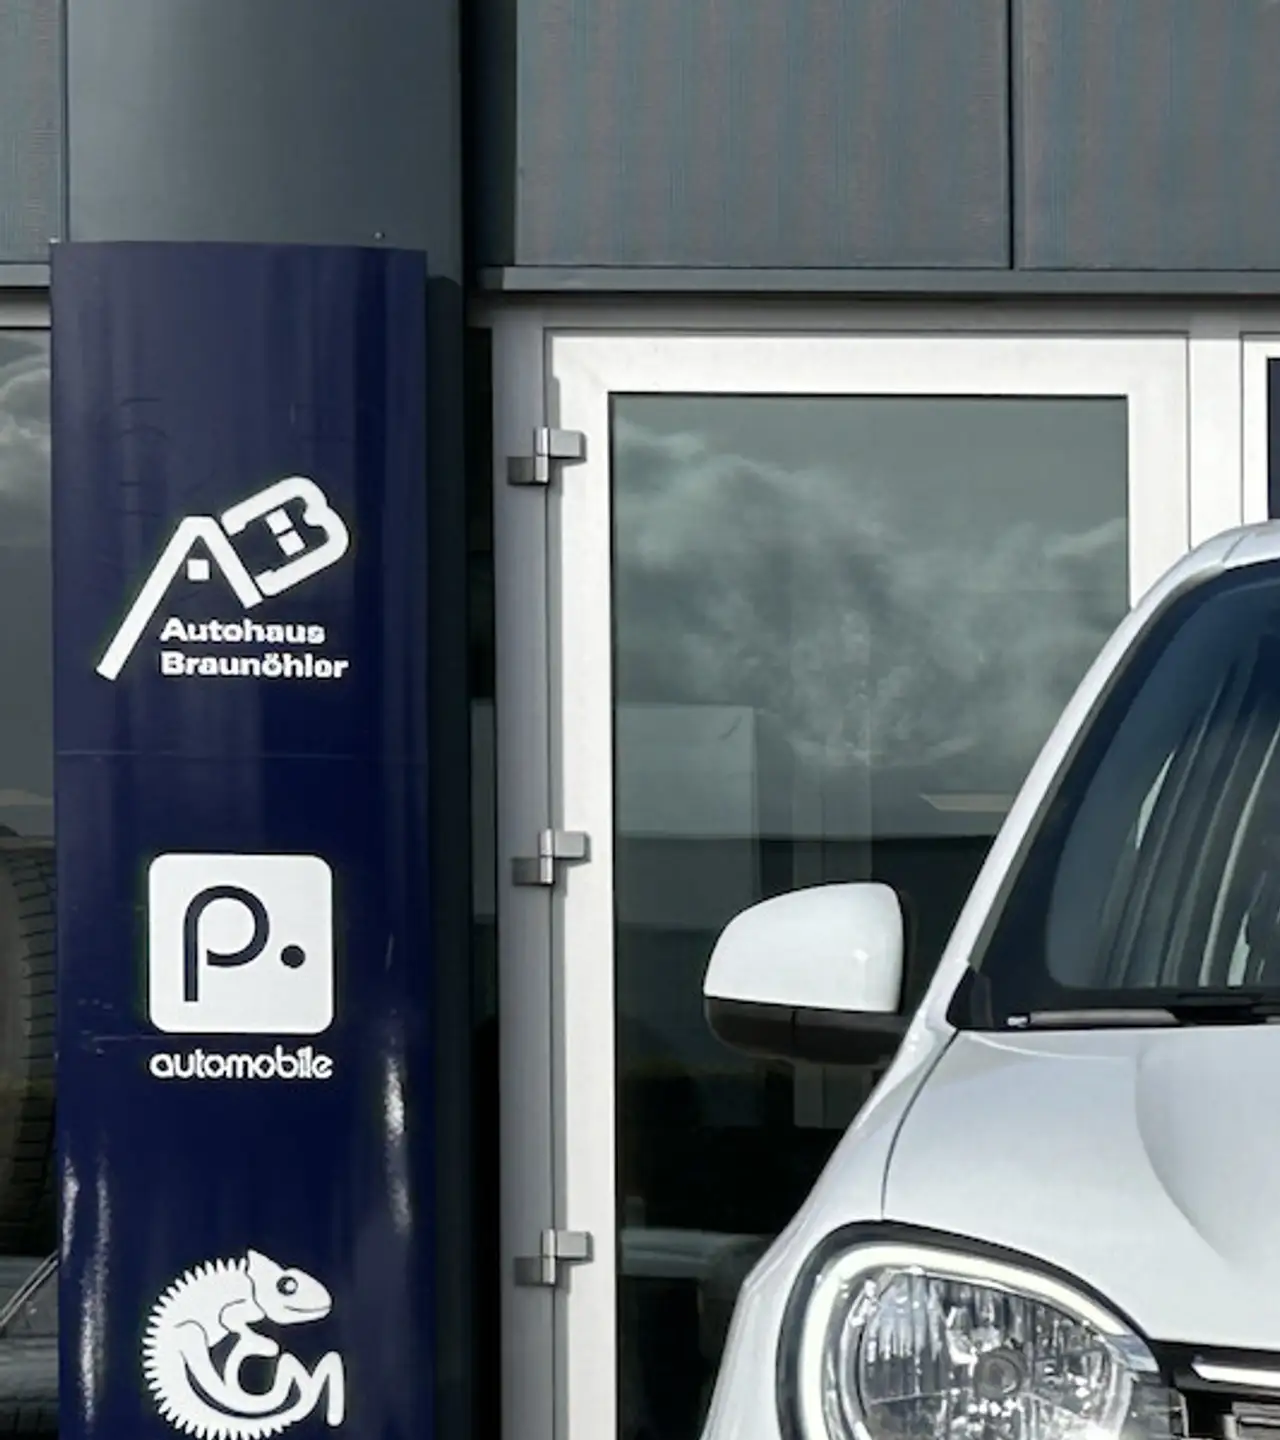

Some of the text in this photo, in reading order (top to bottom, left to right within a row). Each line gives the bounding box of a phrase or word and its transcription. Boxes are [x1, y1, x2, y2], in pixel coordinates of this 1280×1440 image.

[159, 616, 326, 645] Autohaus
[159, 648, 350, 680] Braunöhler
[148, 1046, 335, 1081] automobile
